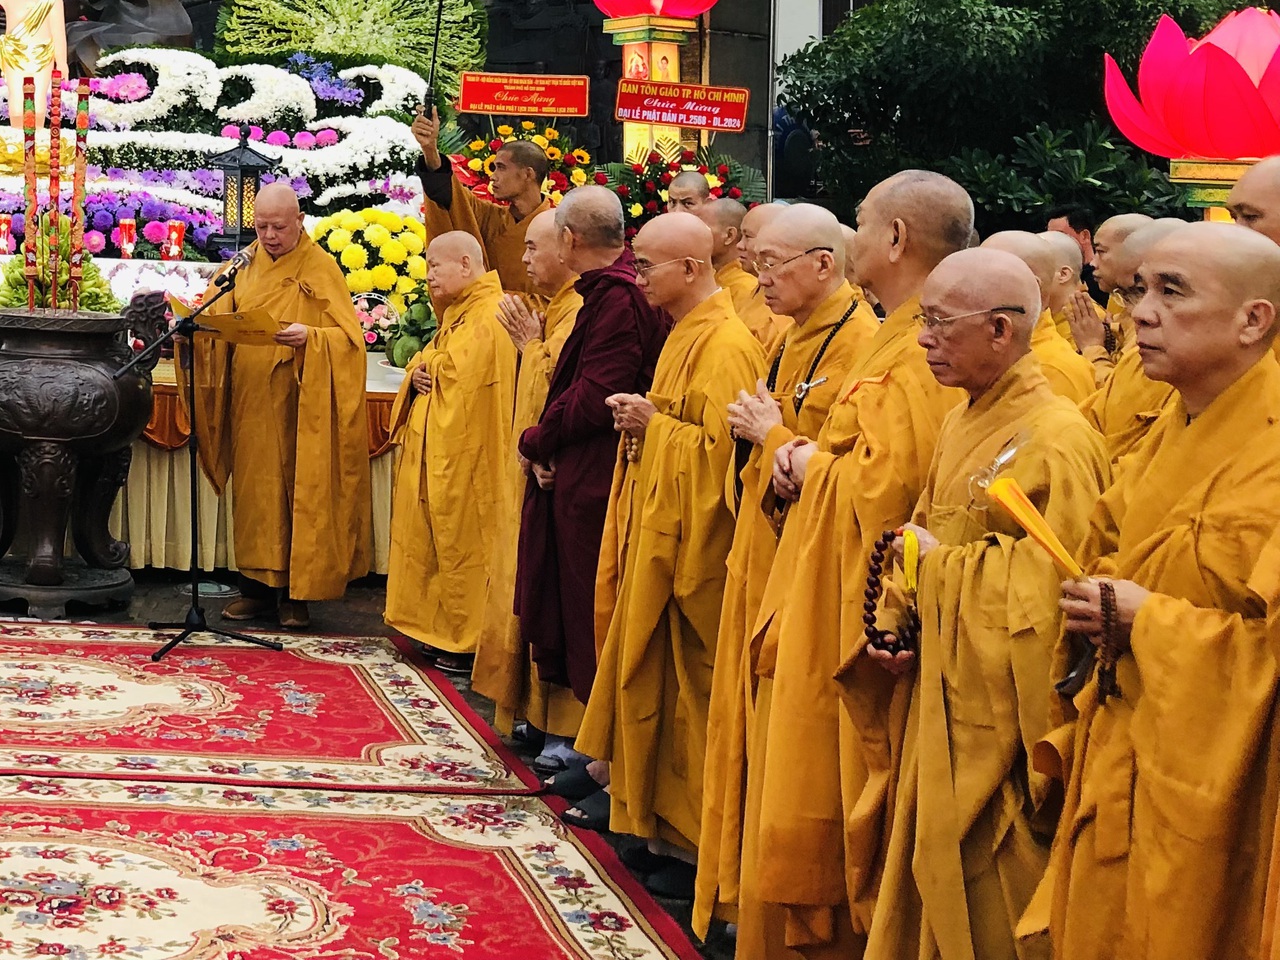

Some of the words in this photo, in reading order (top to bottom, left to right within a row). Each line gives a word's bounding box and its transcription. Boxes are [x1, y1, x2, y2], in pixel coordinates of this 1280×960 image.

[621, 83, 639, 95] BAN
[640, 83, 658, 96] TÔN
[659, 85, 680, 98] GIÁO
[682, 89, 693, 99] TP.
[694, 87, 707, 100] HỒ
[708, 90, 722, 101] CHÍ
[723, 92, 746, 104] MINH
[618, 107, 631, 120] ĐẠI
[631, 106, 641, 119] LỄ
[641, 109, 661, 123] PHẬT
[661, 107, 678, 123] ĐẢN
[643, 98, 677, 109] Chúc
[679, 100, 721, 115] Mừng
